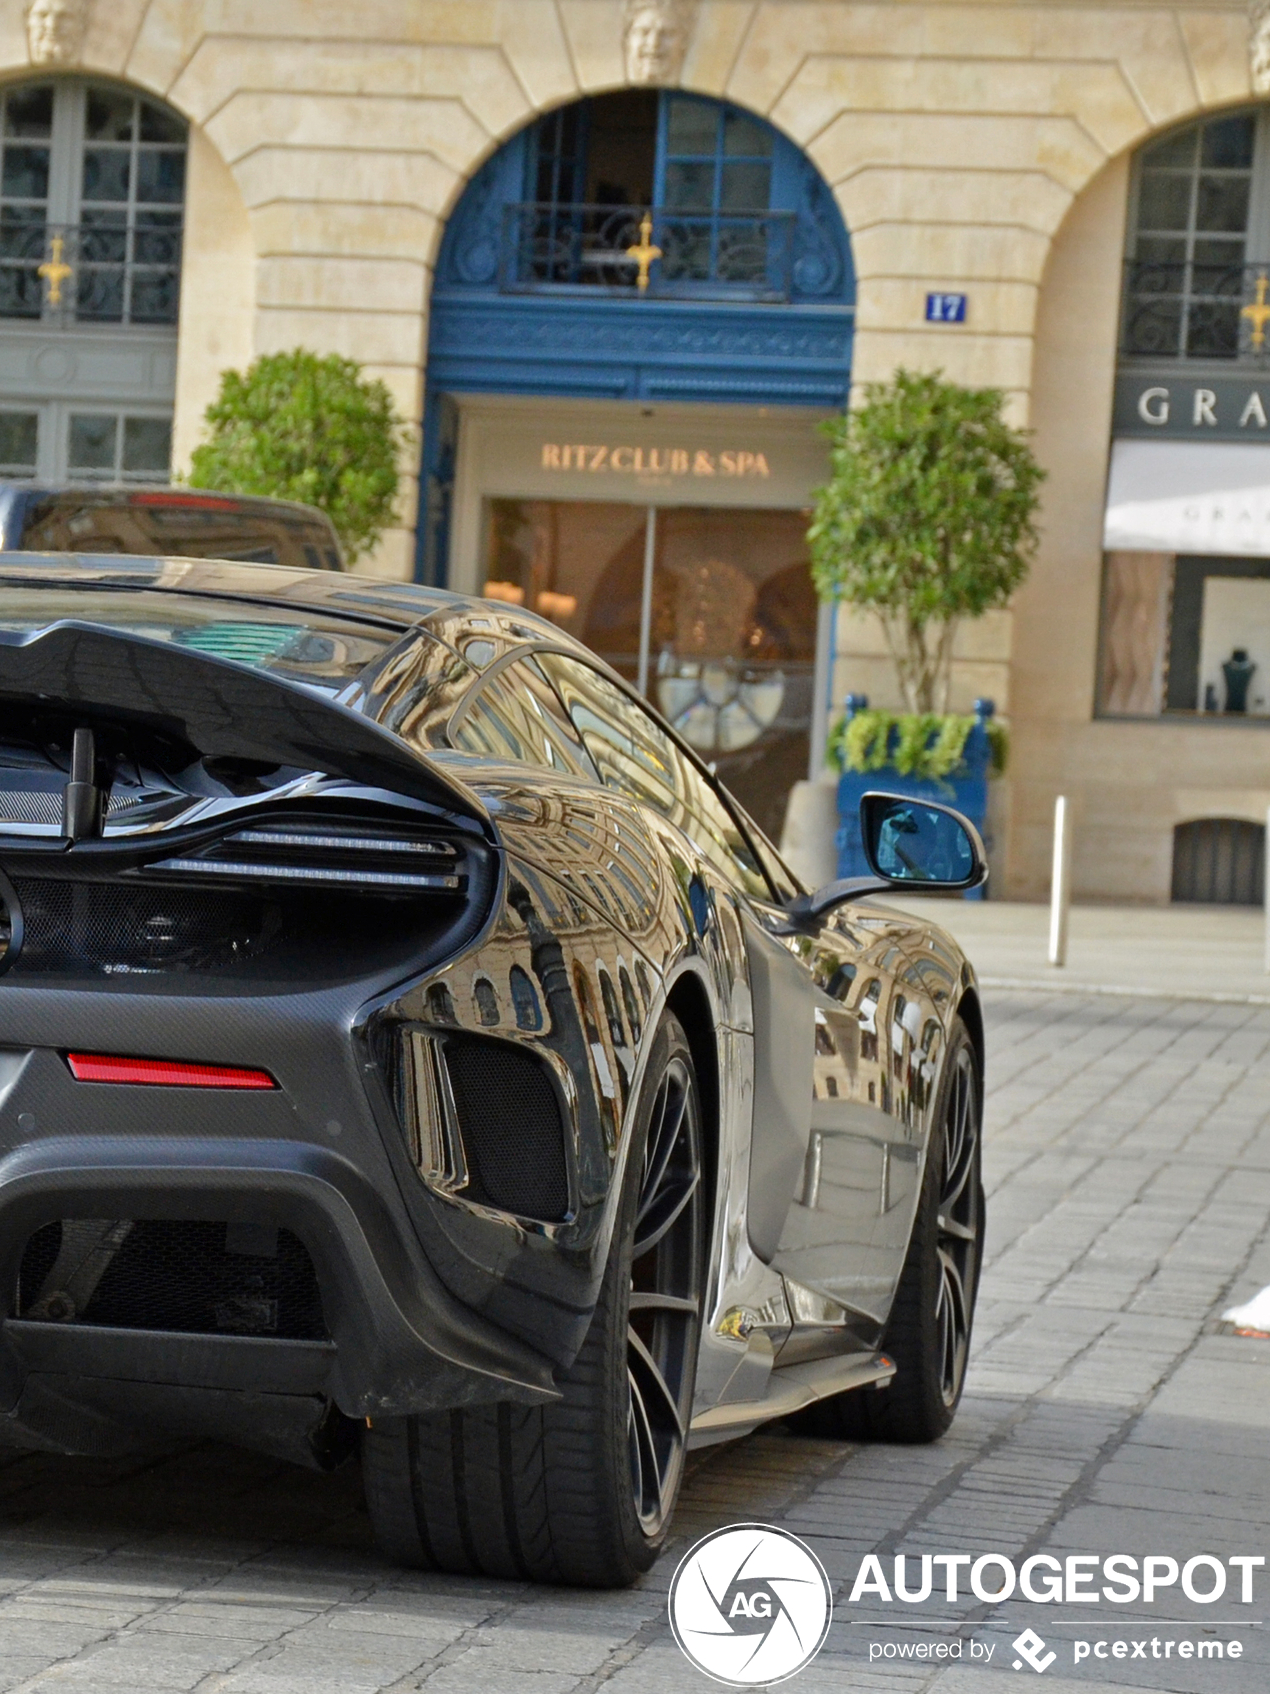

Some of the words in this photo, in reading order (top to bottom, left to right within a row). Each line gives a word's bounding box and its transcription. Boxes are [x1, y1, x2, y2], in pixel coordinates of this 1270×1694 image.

[932, 295, 962, 320] 17
[693, 450, 715, 476] &
[719, 451, 769, 478] SPA
